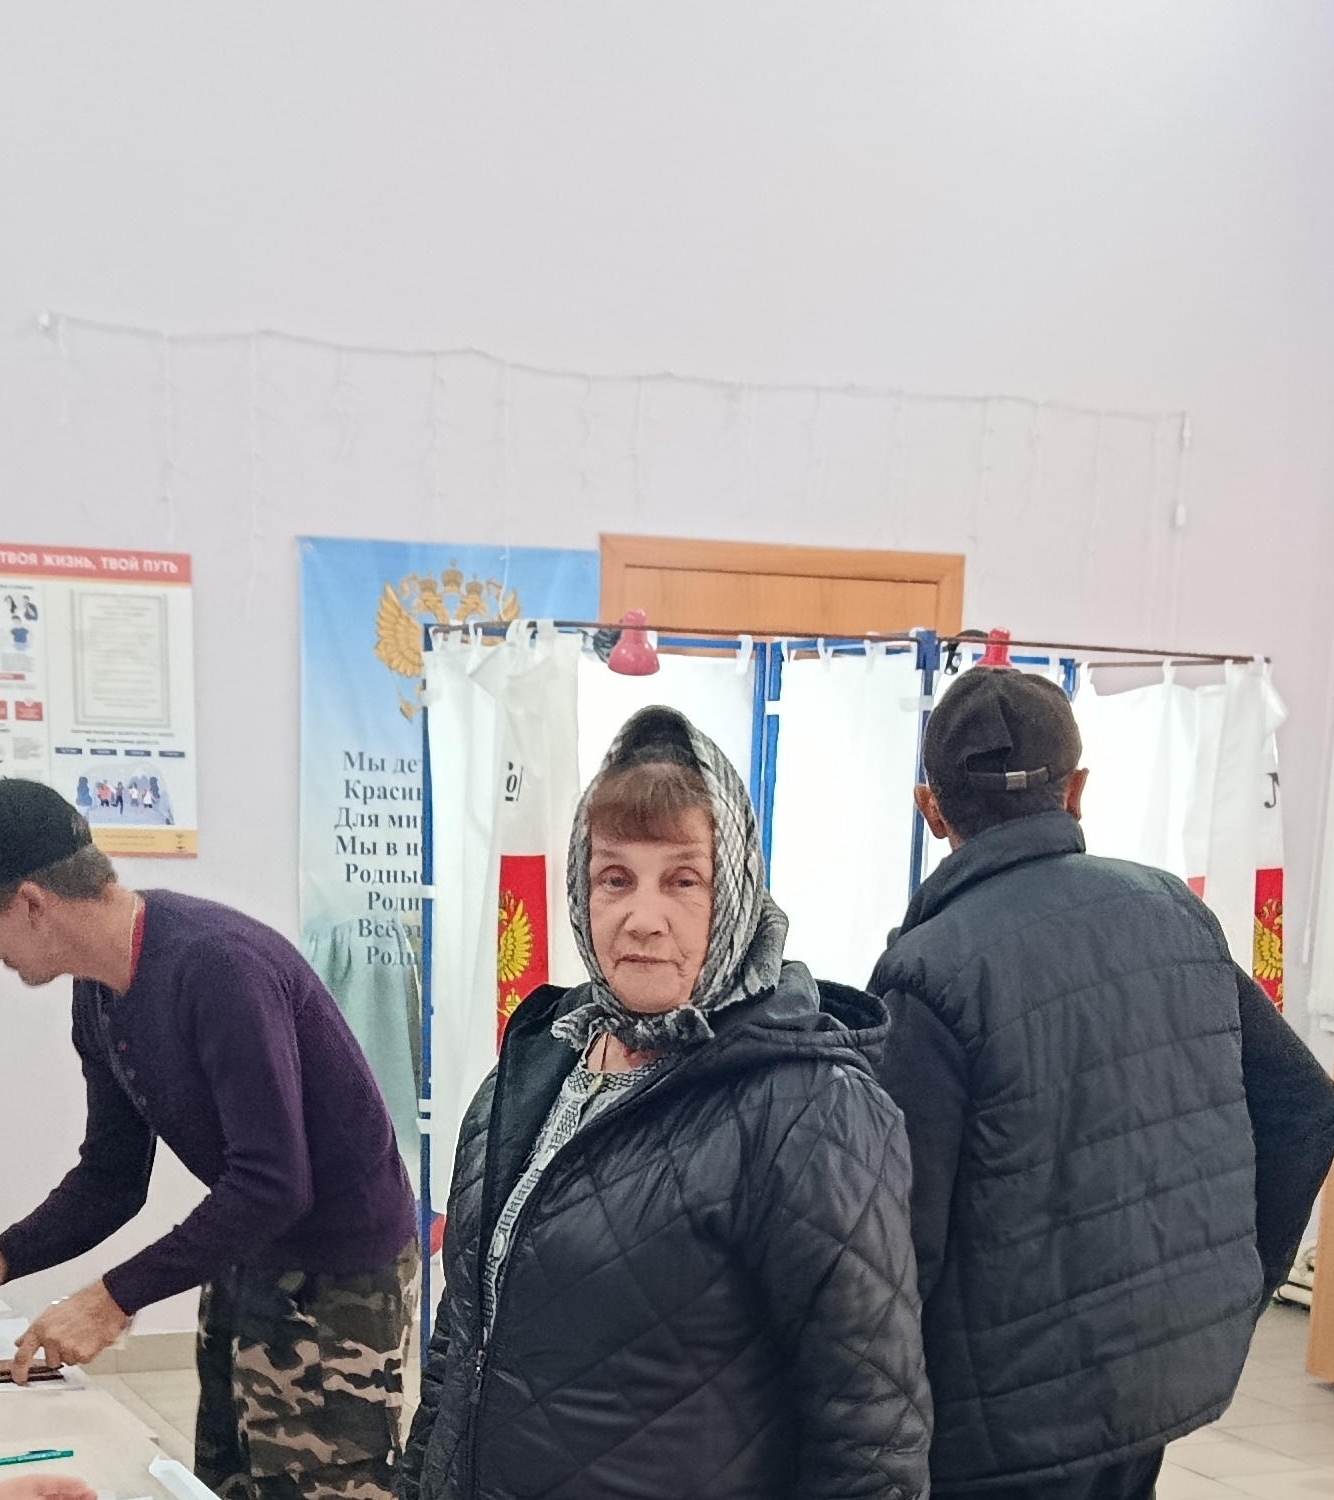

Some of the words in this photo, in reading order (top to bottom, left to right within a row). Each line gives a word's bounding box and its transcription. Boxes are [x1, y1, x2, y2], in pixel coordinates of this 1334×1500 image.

[0, 551, 39, 566] ТВОЯ
[42, 553, 96, 571] ЖИЗНЬ,
[101, 555, 139, 572] ТВОЙ
[143, 558, 179, 574] ПУТЬ
[343, 750, 385, 772] Мы
[393, 757, 422, 773] де
[334, 806, 379, 831] Для
[335, 835, 377, 855] Мы
[386, 842, 398, 855] в
[406, 842, 423, 856] н
[367, 891, 422, 912] Родн
[358, 917, 398, 938] Всё
[366, 945, 422, 966] Родн
